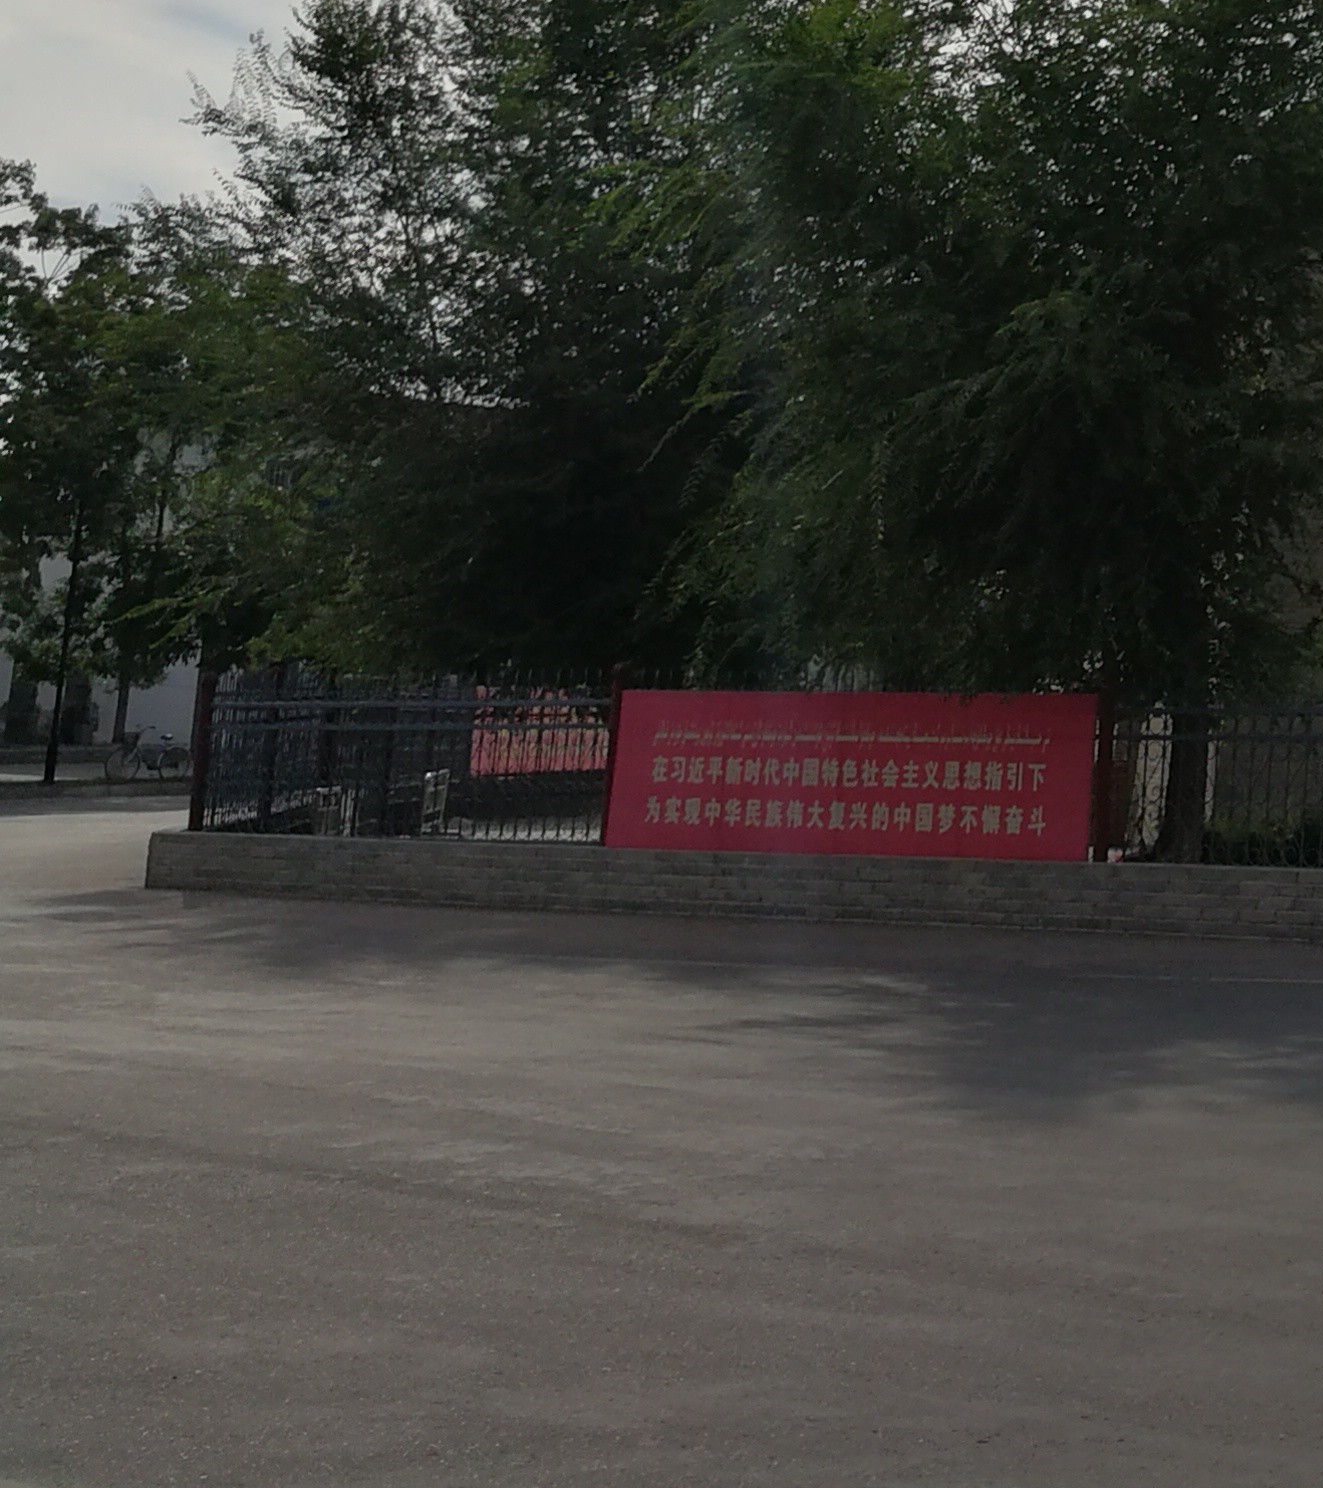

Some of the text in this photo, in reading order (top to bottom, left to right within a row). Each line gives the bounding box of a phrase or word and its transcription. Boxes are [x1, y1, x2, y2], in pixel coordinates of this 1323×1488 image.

[651, 754, 1047, 792] 在习近平新时代中国特色社会主义思想指引下
[643, 794, 1047, 837] 为实现中华民族伟大复兴的中国梦不懈奋斗
